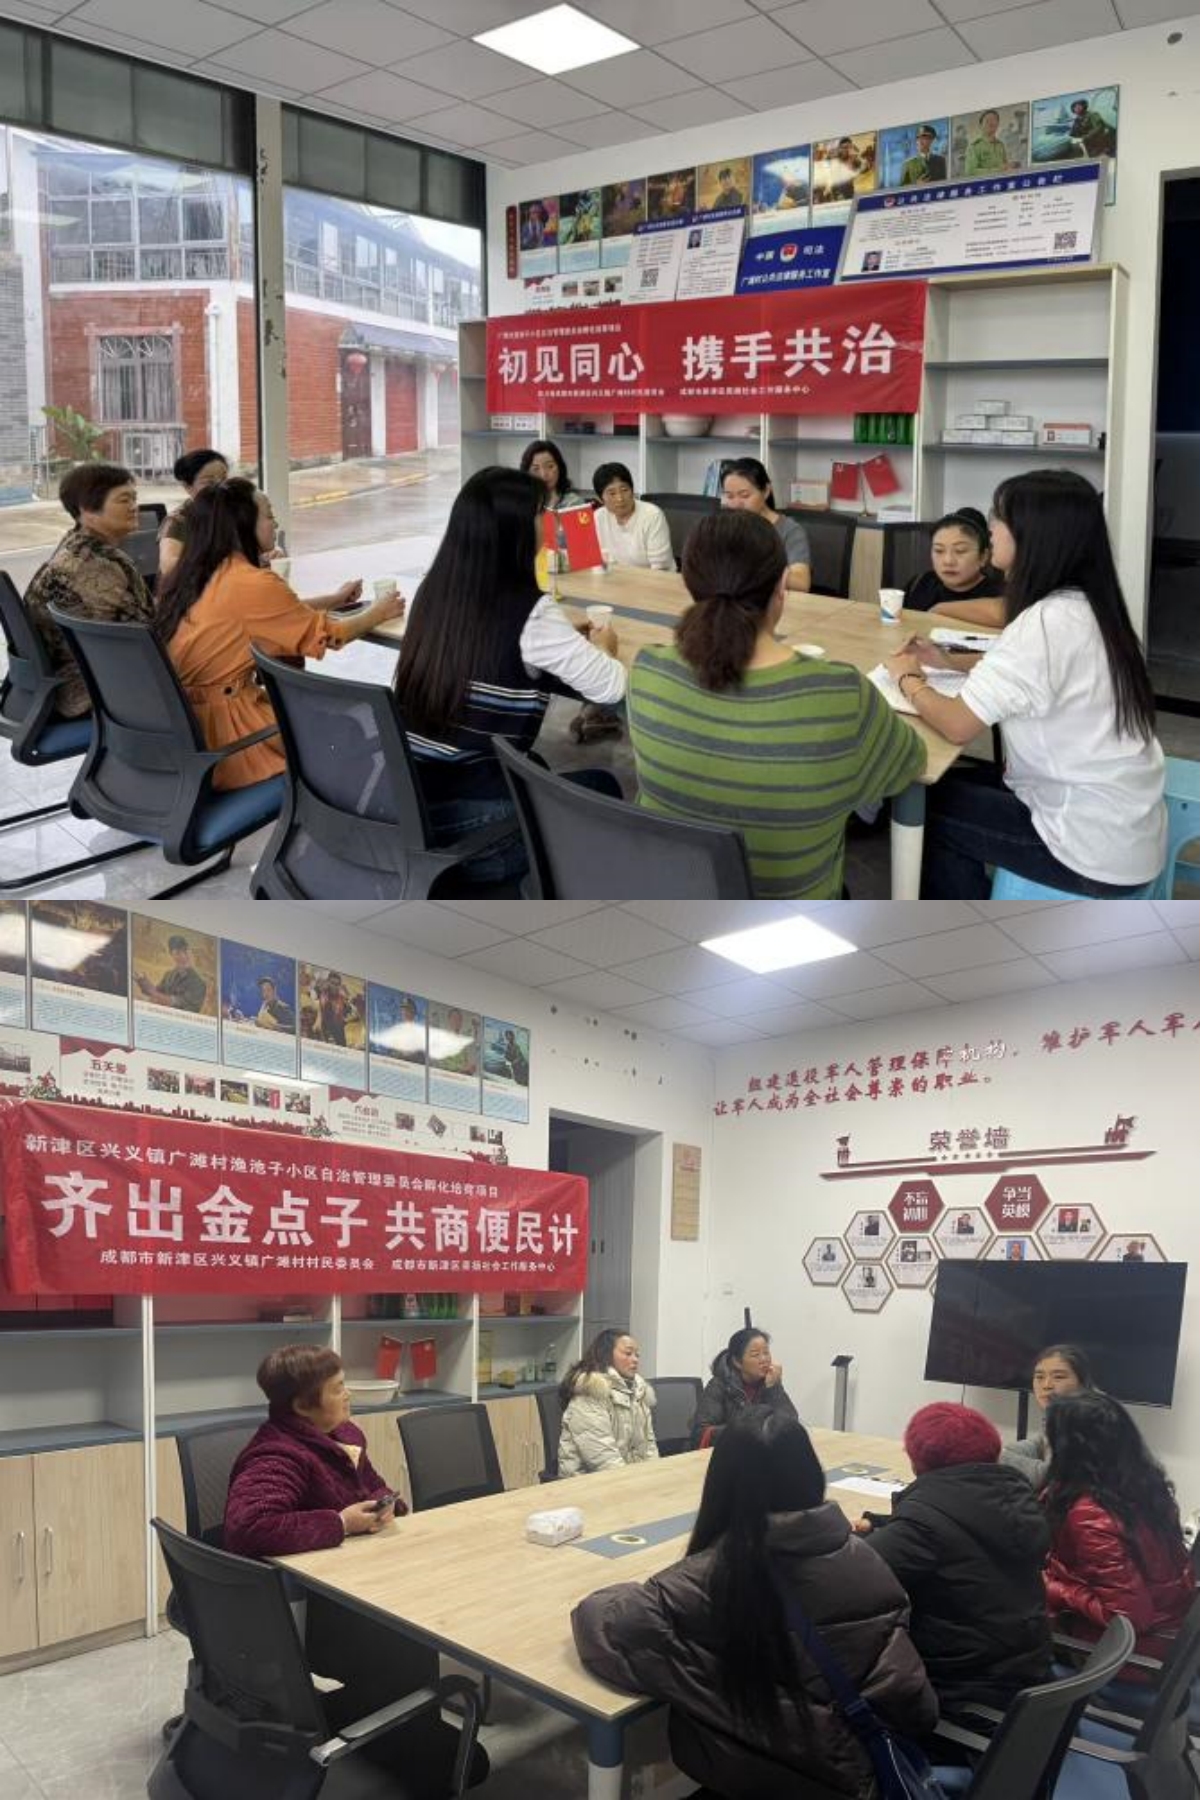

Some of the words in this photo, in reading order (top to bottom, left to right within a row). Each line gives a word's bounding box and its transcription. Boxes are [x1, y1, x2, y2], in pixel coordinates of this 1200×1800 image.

[498, 342, 645, 385] 初见同心
[682, 321, 897, 382] 携手共治
[928, 1125, 1012, 1151] 荣誉墙
[24, 1133, 499, 1199] 新津区兴义镇广滩村渔池子小区自治管理委员会孵化培育项目
[41, 1170, 368, 1249] 齐出金点子
[385, 1200, 579, 1256] 共商便民计
[1002, 1186, 1032, 1202] 争当
[99, 1249, 375, 1270] 成都市新津区兴义镇广滩村村民委员会
